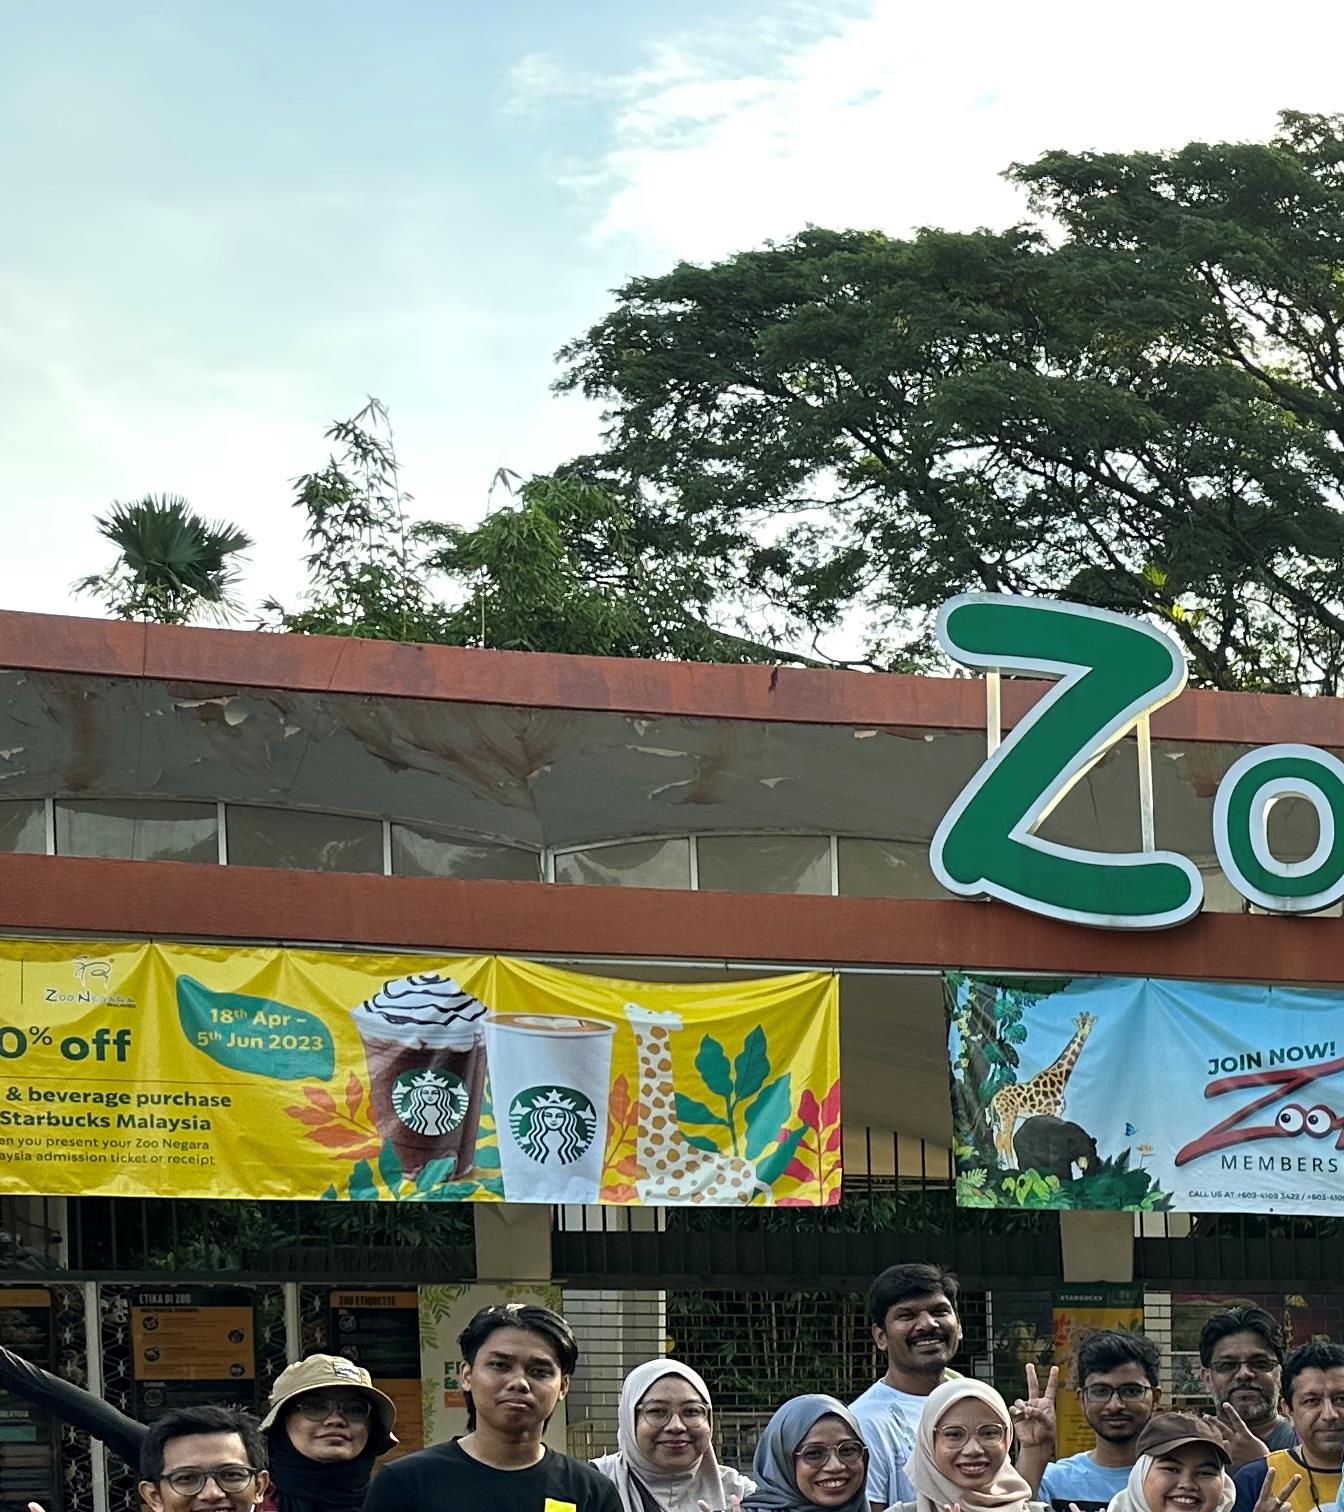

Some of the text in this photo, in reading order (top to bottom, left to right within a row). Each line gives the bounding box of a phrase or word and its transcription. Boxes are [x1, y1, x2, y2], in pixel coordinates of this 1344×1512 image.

[210, 1008, 248, 1024] 18th
[252, 1010, 291, 1029] Apr
[60, 1027, 132, 1062] off
[197, 1031, 323, 1051] 5th Jun 2023
[1208, 1041, 1336, 1075] JOIN NOW!
[6, 1086, 231, 1108] & beverage purchase
[0, 1110, 212, 1132] Starbucks Malaysia
[18, 1137, 42, 1150] you
[46, 1137, 98, 1151] present
[102, 1138, 132, 1150] your
[135, 1137, 159, 1149] Zoo
[162, 1138, 210, 1151] Negara
[36, 1150, 108, 1164] admission
[111, 1152, 148, 1164] ticket
[150, 1154, 164, 1164] or
[167, 1154, 216, 1167] receipt
[1188, 1190, 1209, 1198] CALL
